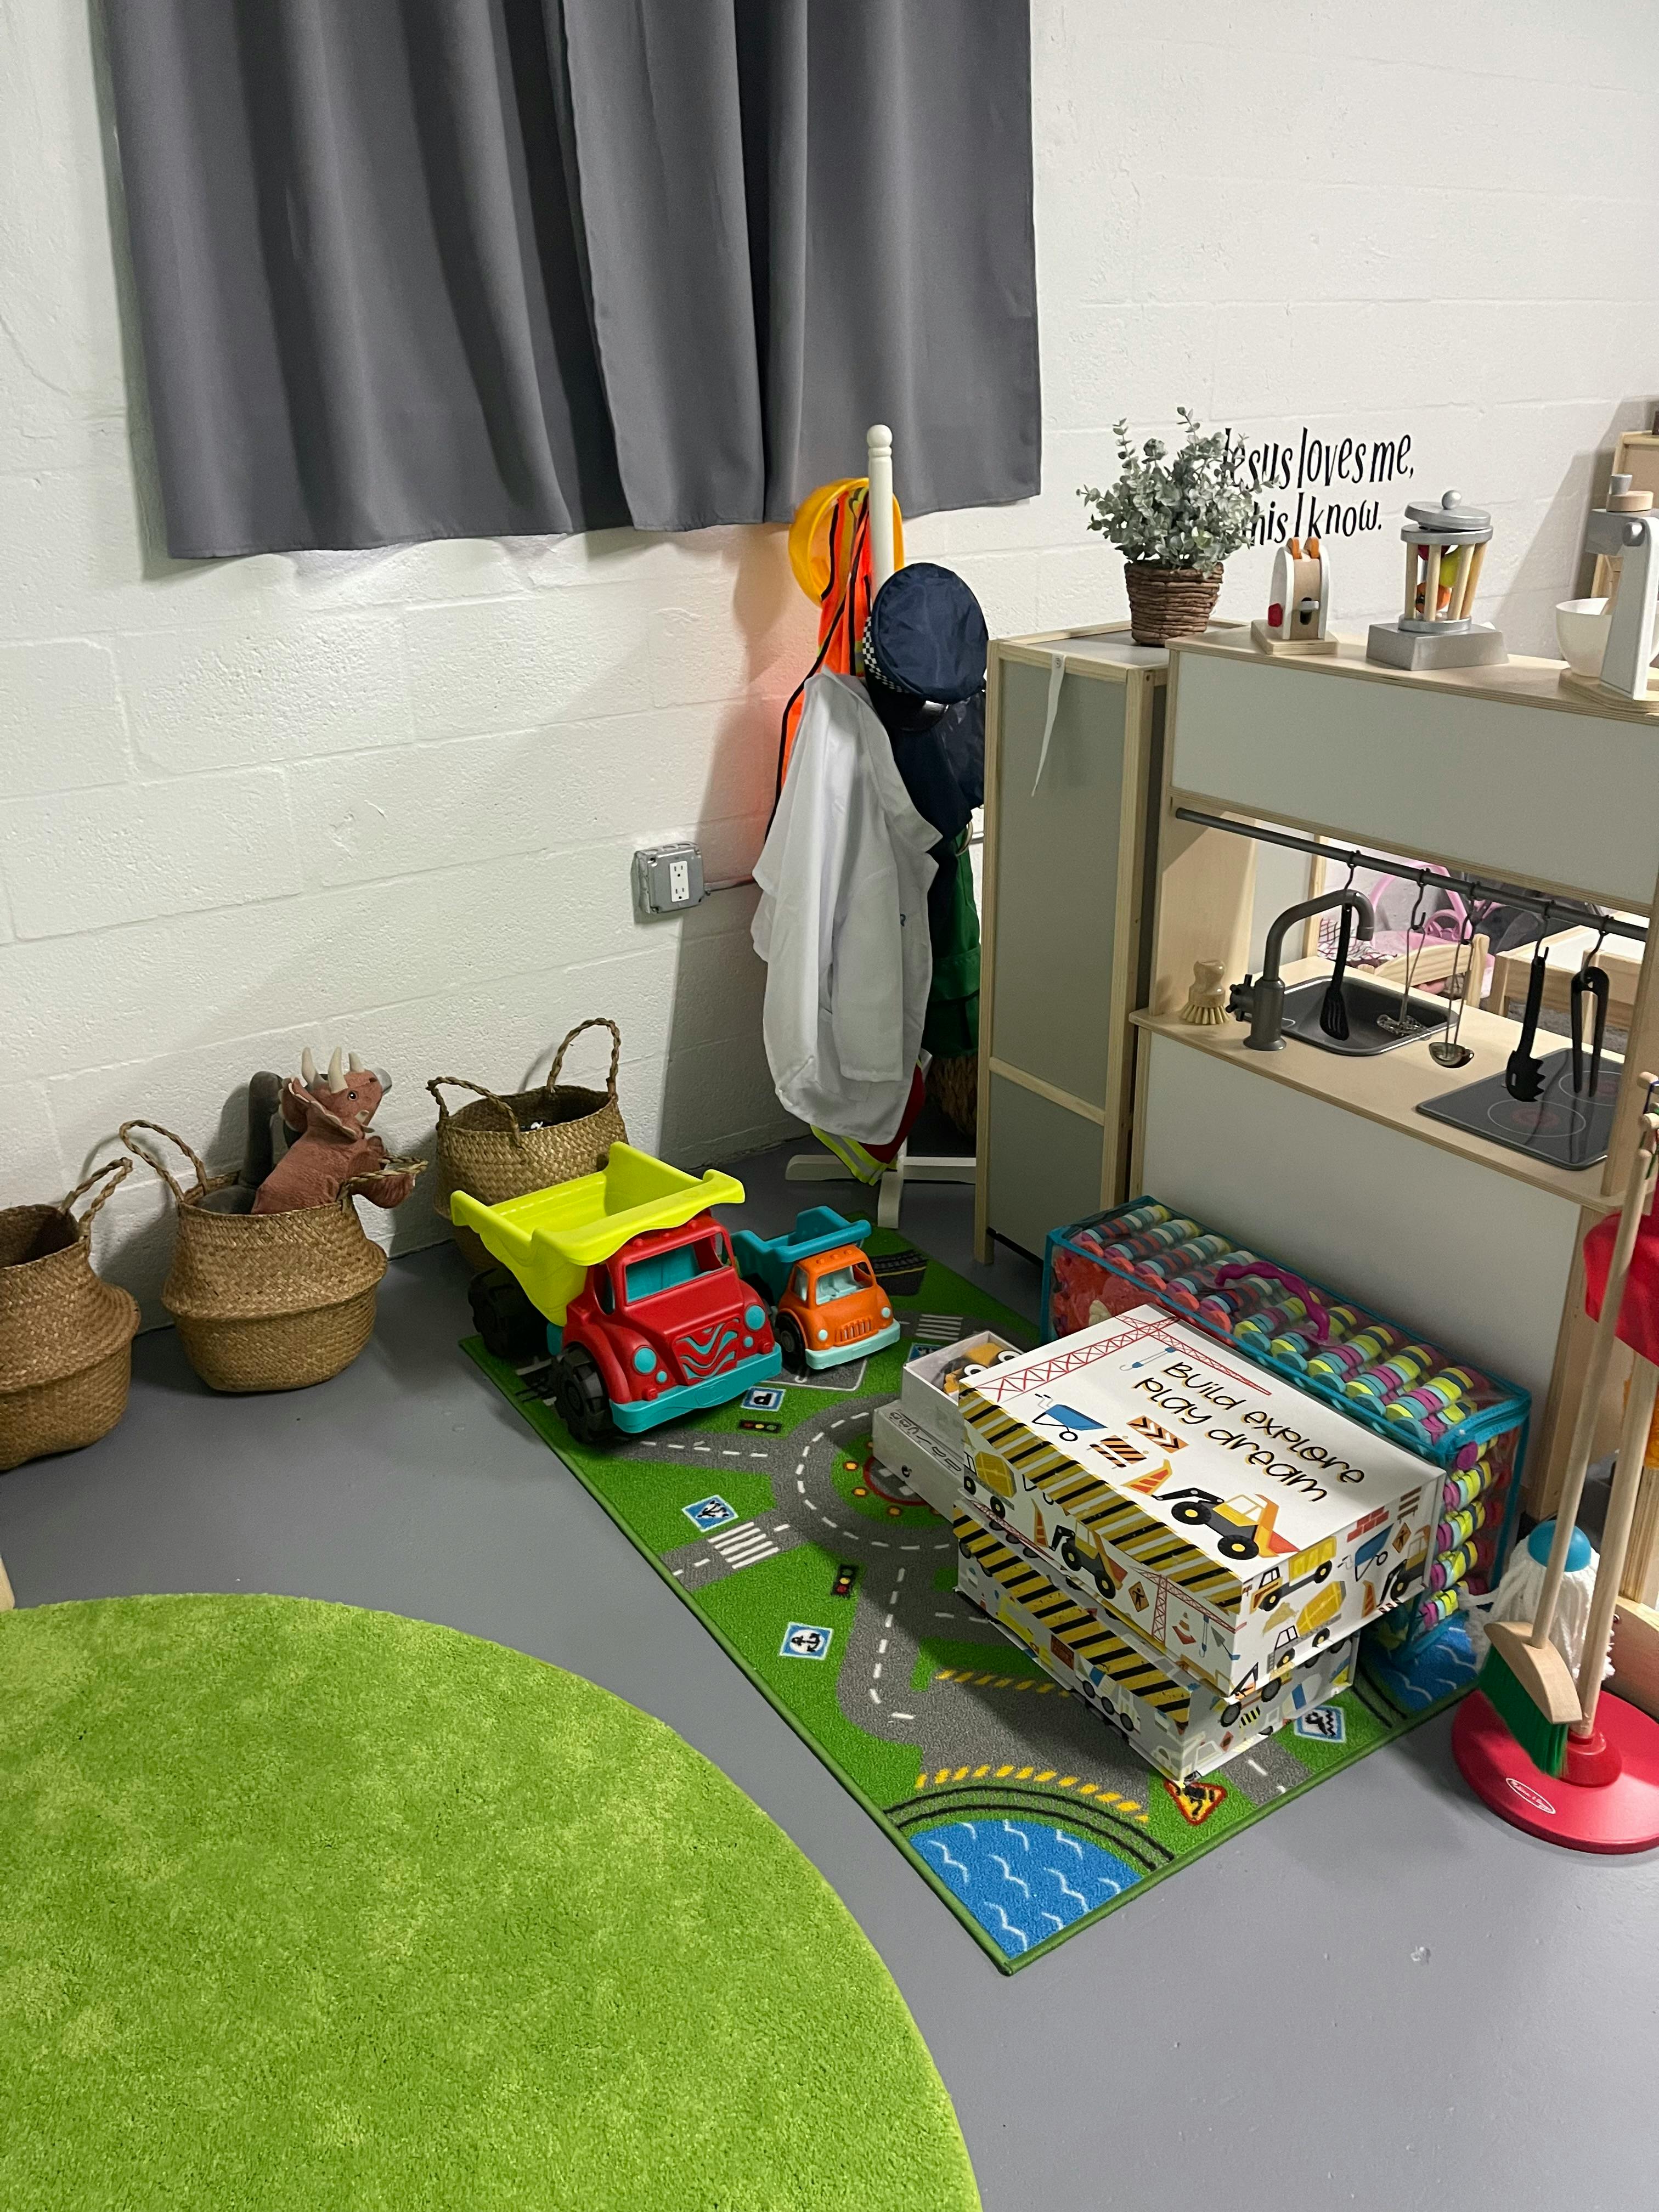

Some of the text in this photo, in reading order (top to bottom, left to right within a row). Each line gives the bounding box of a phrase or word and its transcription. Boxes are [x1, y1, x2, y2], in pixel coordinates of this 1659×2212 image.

[1297, 426, 1366, 488] loves
[1369, 434, 1414, 482] me,
[1242, 492, 1381, 546] his I know.
[1132, 1377, 1328, 1503] play dream
[1161, 1361, 1365, 1484] Build explore
